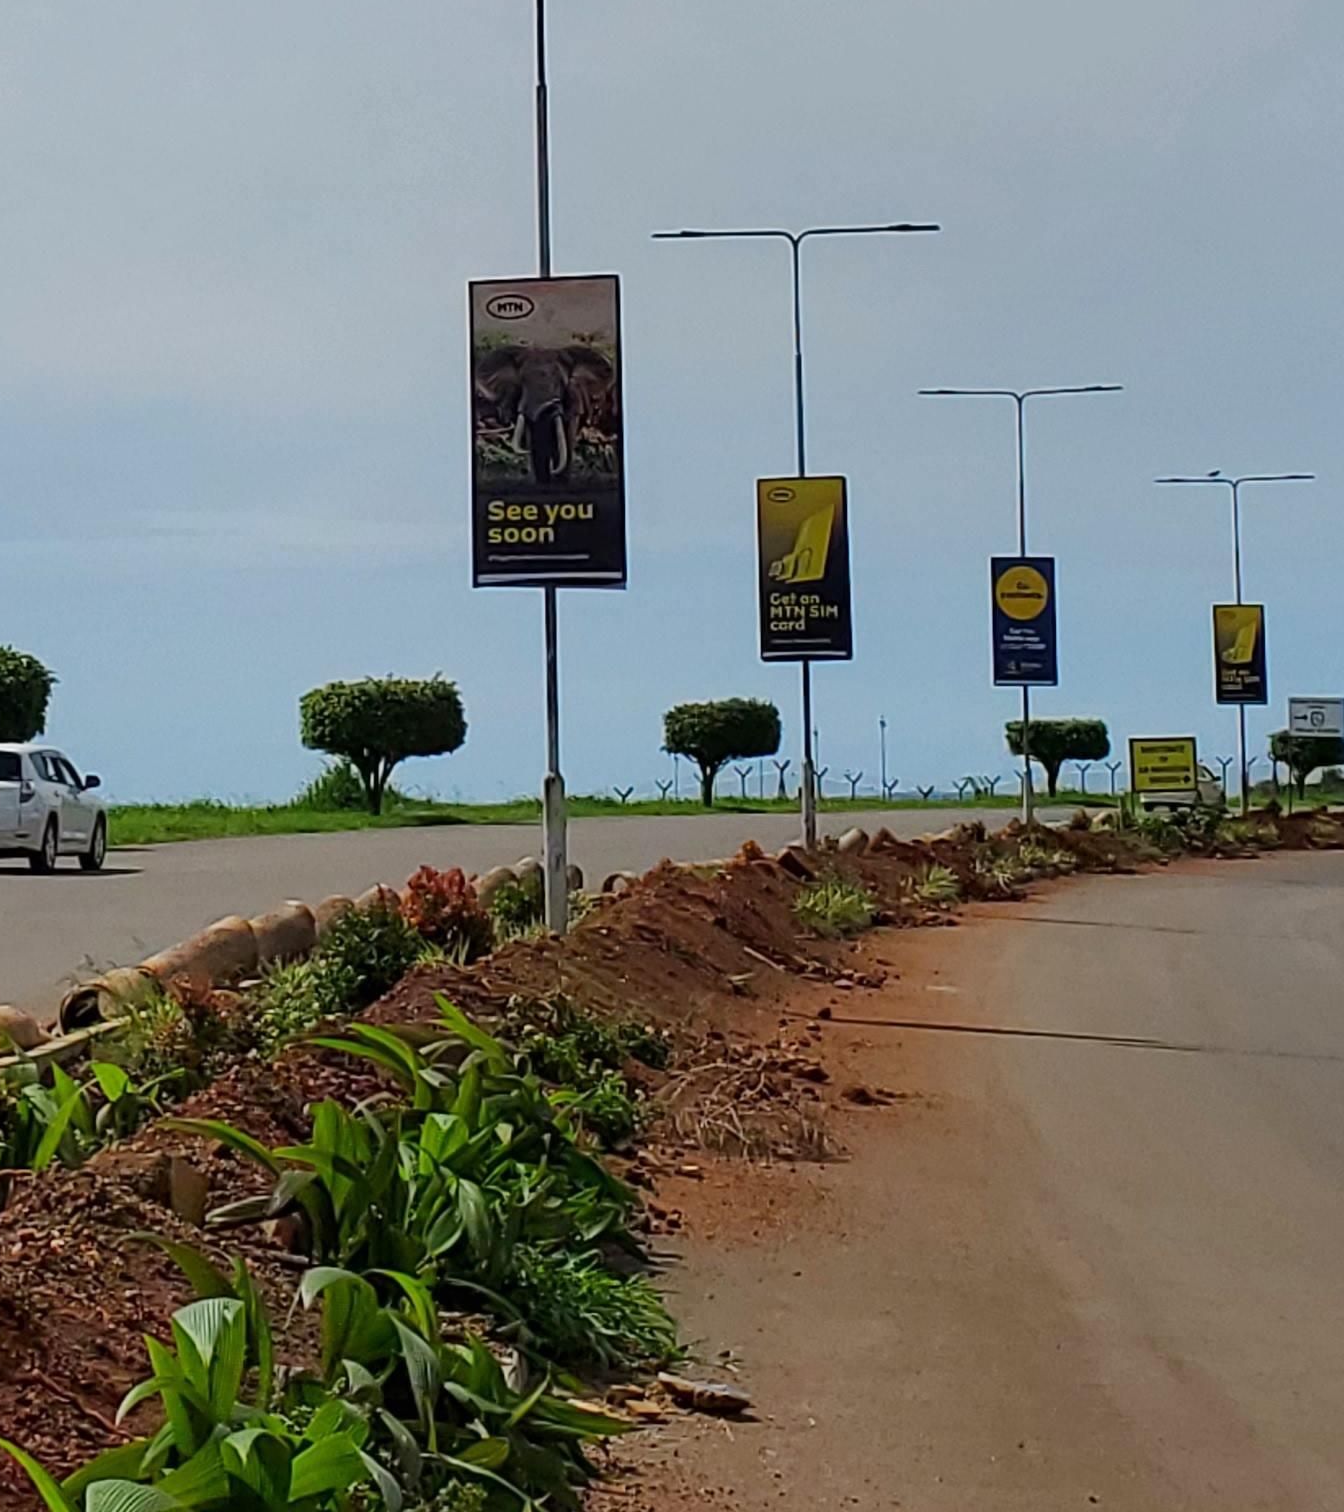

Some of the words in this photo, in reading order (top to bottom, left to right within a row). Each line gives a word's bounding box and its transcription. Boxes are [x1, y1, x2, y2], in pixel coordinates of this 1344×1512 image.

[497, 302, 524, 313] MTN
[488, 500, 538, 521] See
[546, 503, 593, 525] you
[488, 525, 555, 544] soon
[770, 592, 797, 605] Get
[800, 594, 820, 605] an
[770, 605, 805, 618] MTN
[809, 605, 839, 619] SIM
[770, 618, 806, 631] card
